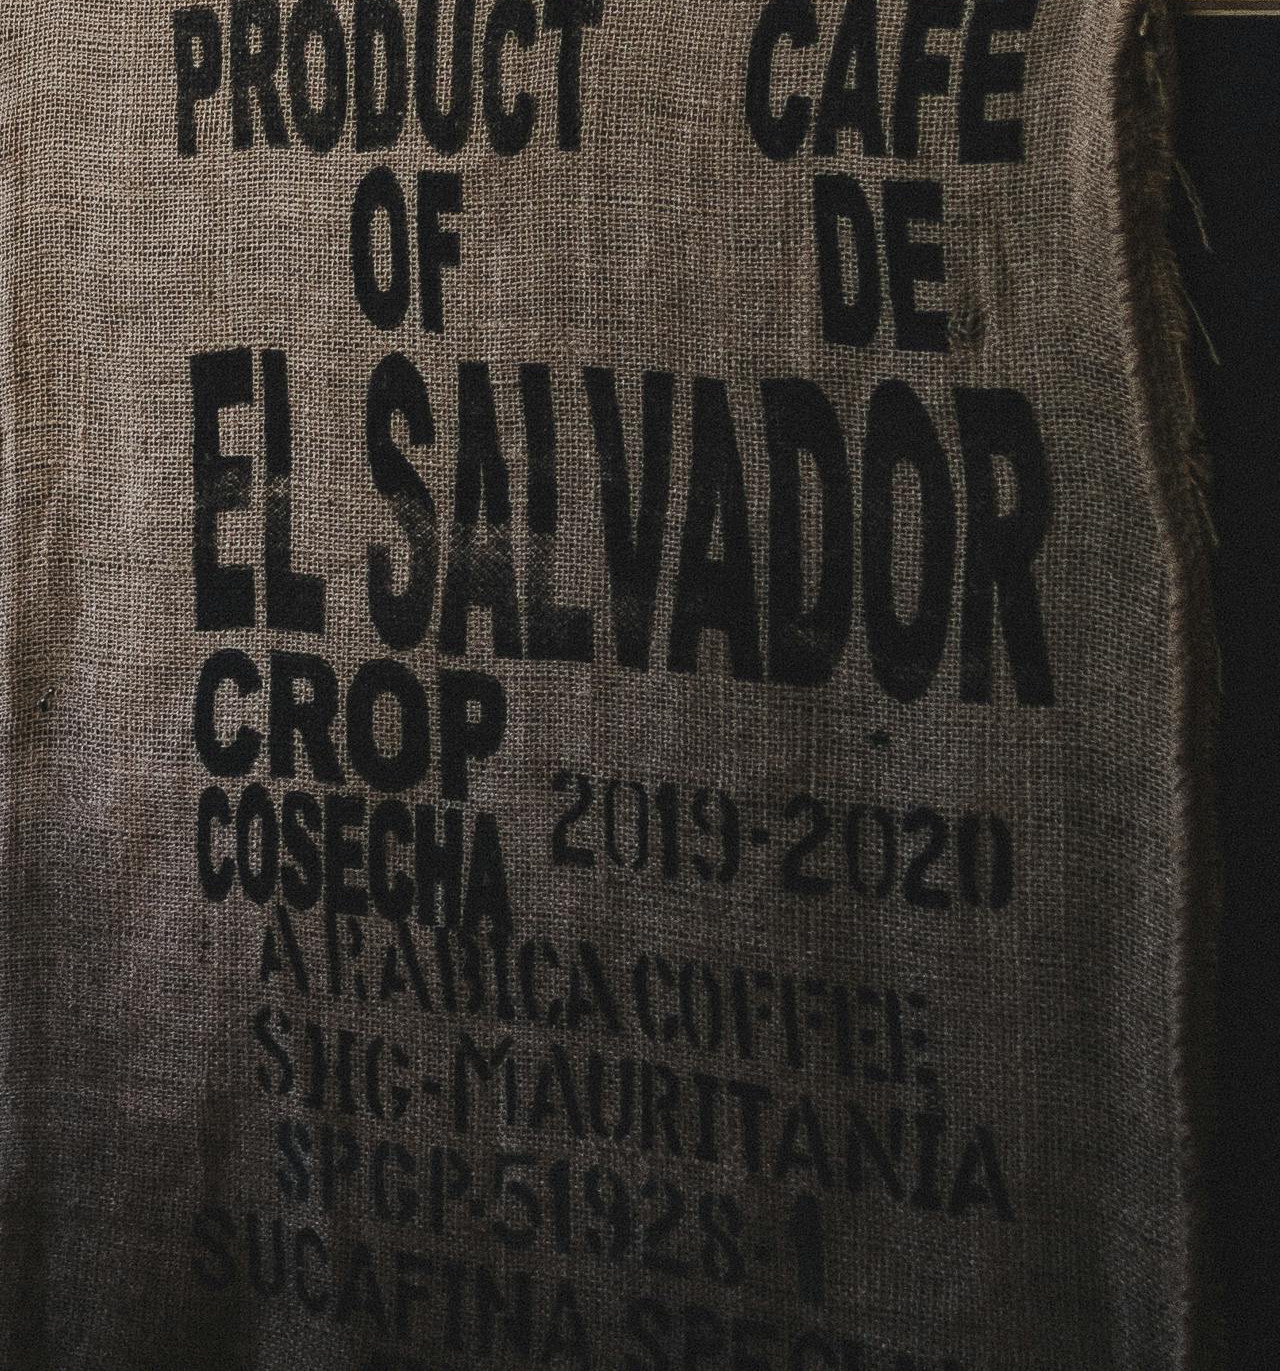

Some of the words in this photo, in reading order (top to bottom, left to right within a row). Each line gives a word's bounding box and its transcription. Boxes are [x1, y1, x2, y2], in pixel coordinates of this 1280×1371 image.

[350, 165, 464, 333] OF
[813, 173, 950, 353] DE
[189, 347, 325, 633] EL
[366, 351, 1056, 707] SALVADOR
[195, 648, 507, 801] CROP
[197, 782, 513, 933] COSECHA
[552, 771, 1015, 910] 2019-2020
[260, 904, 622, 1033] ARABICA
